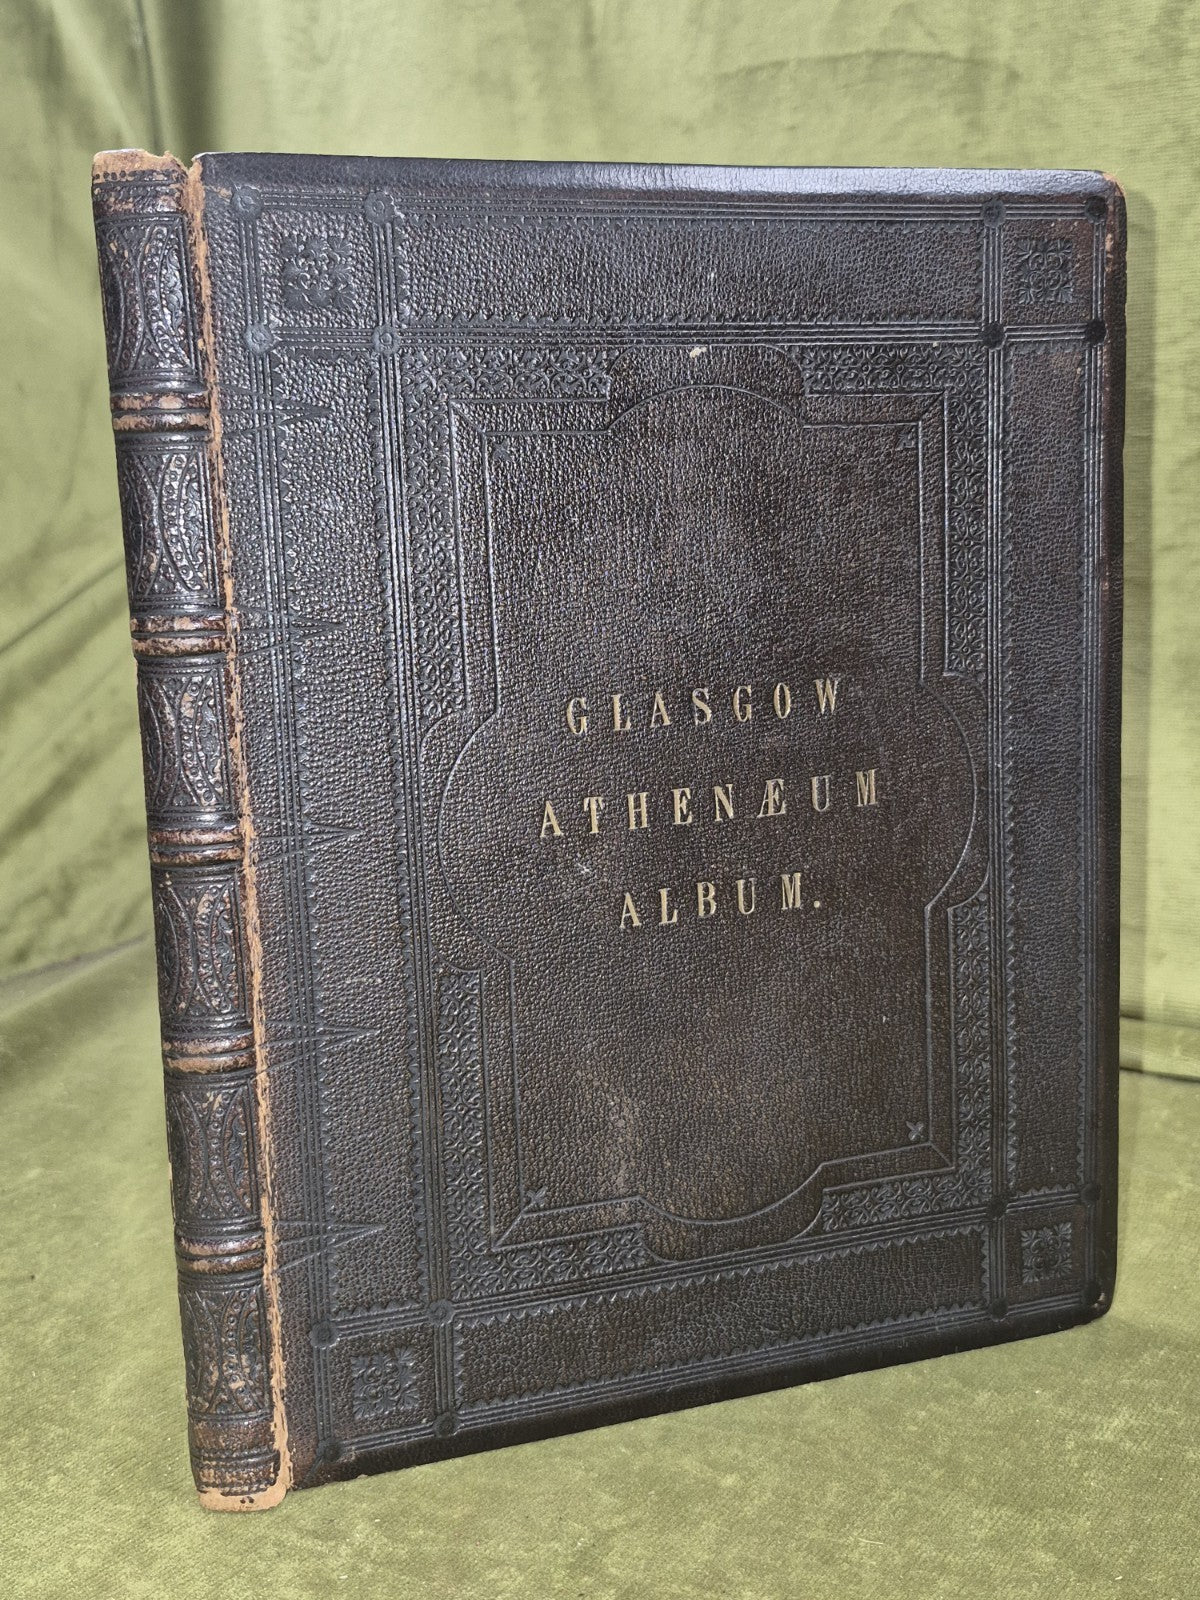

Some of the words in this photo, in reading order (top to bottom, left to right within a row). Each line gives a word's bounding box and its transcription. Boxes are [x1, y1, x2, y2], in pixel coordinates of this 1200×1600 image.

[565, 677, 841, 735] GLASGOW
[539, 768, 878, 838] ATHENÆUM
[618, 872, 821, 929] ALBUM.
